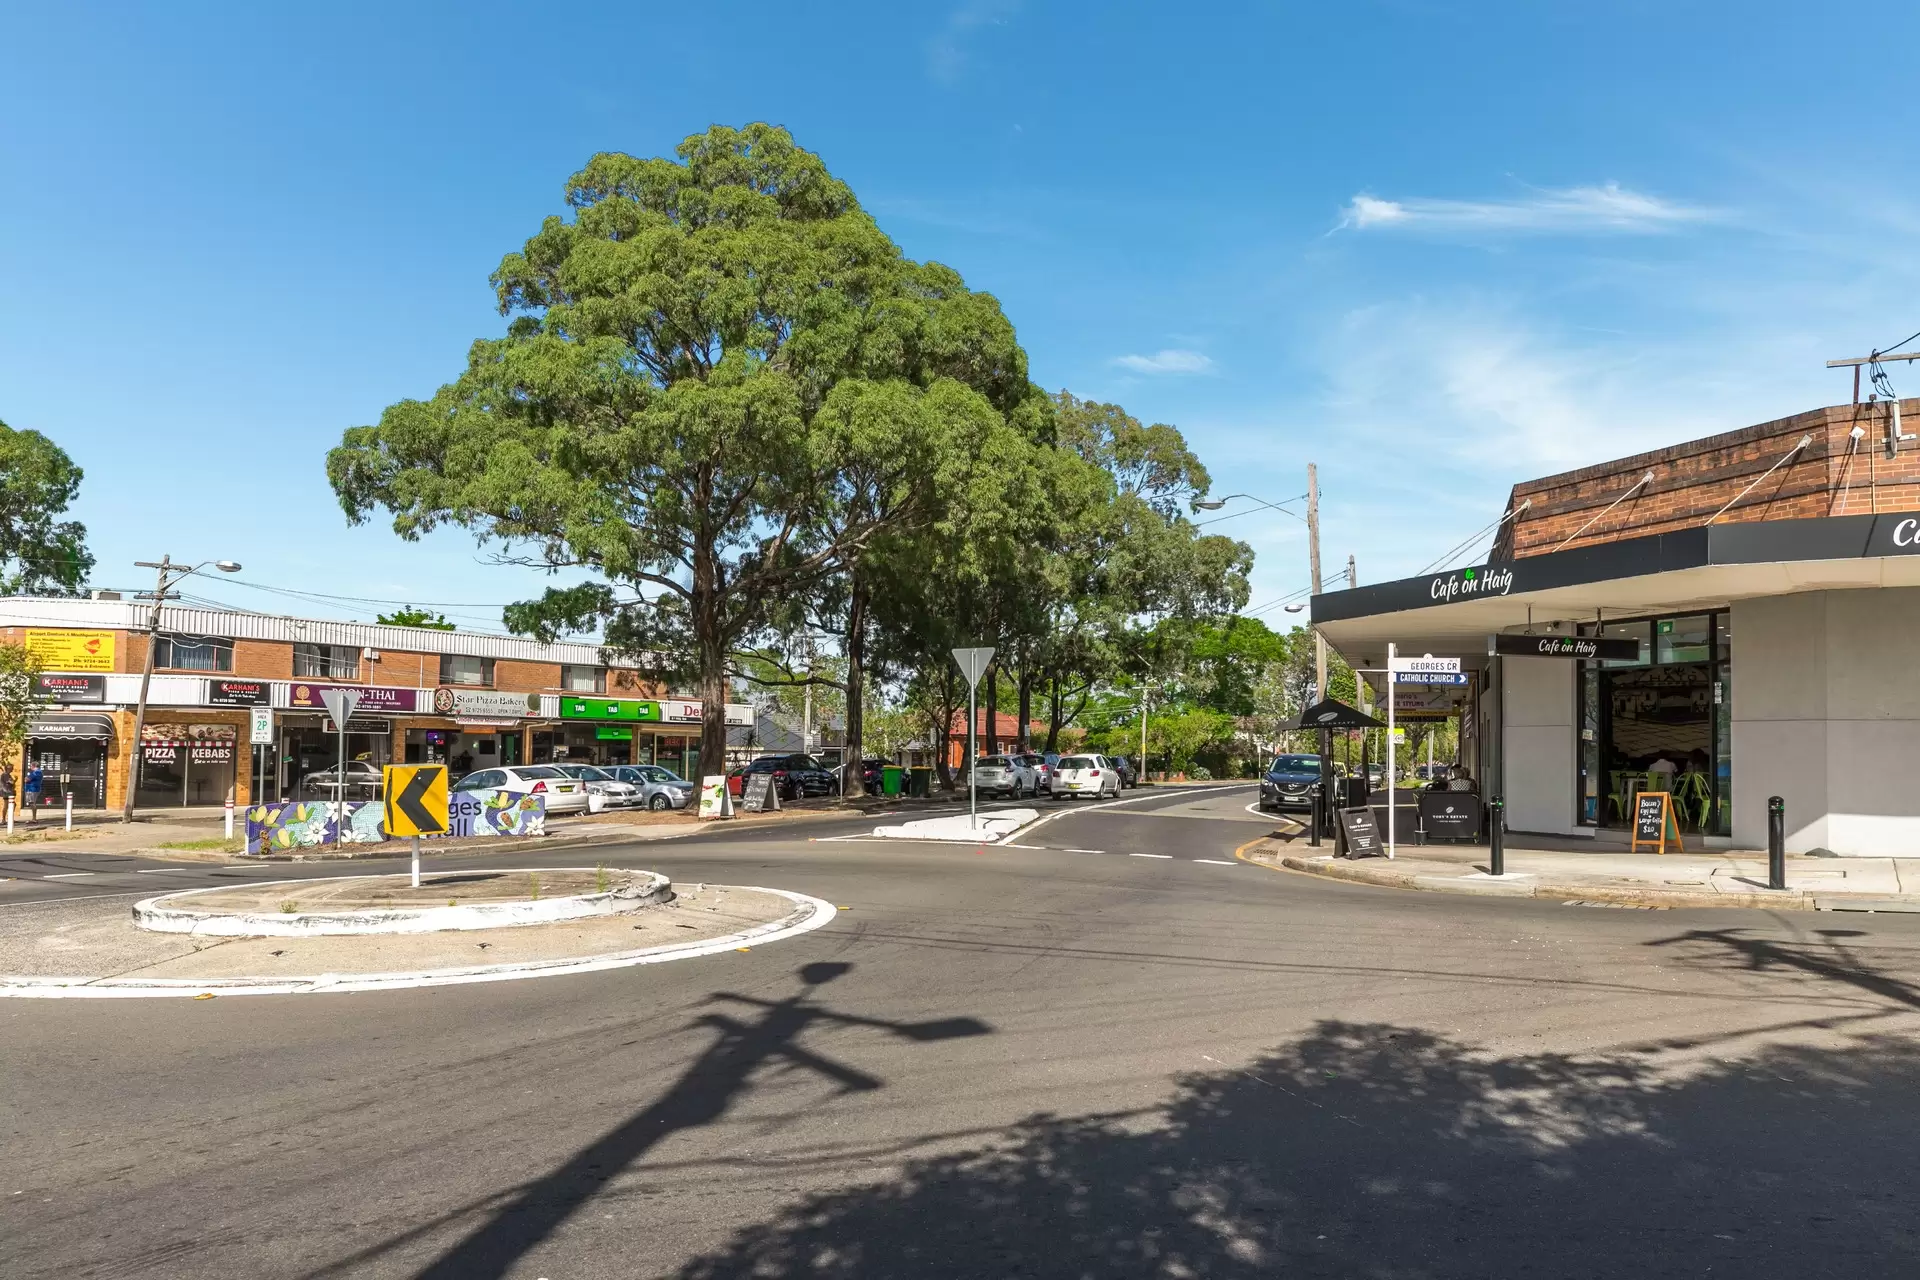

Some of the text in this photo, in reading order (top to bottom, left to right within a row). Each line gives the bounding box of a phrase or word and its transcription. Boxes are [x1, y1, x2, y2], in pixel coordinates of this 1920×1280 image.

[1431, 568, 1513, 601] Cafe on Haig
[1539, 639, 1597, 658] Cafe on Haig
[1410, 662, 1457, 670] GEORGES CR
[42, 677, 89, 687] KARHANI'S
[1400, 673, 1455, 683] CATHOLIC CHURCH
[220, 682, 260, 692] KARHANI'S
[456, 694, 526, 707] Star Pizza Bakery
[575, 704, 585, 712] TAB
[38, 725, 76, 733] KARHANI'S
[256, 720, 268, 731] 2P
[145, 748, 231, 758] PIZZA KEBABS
[446, 817, 468, 837] all
[1643, 825, 1655, 834] $10
